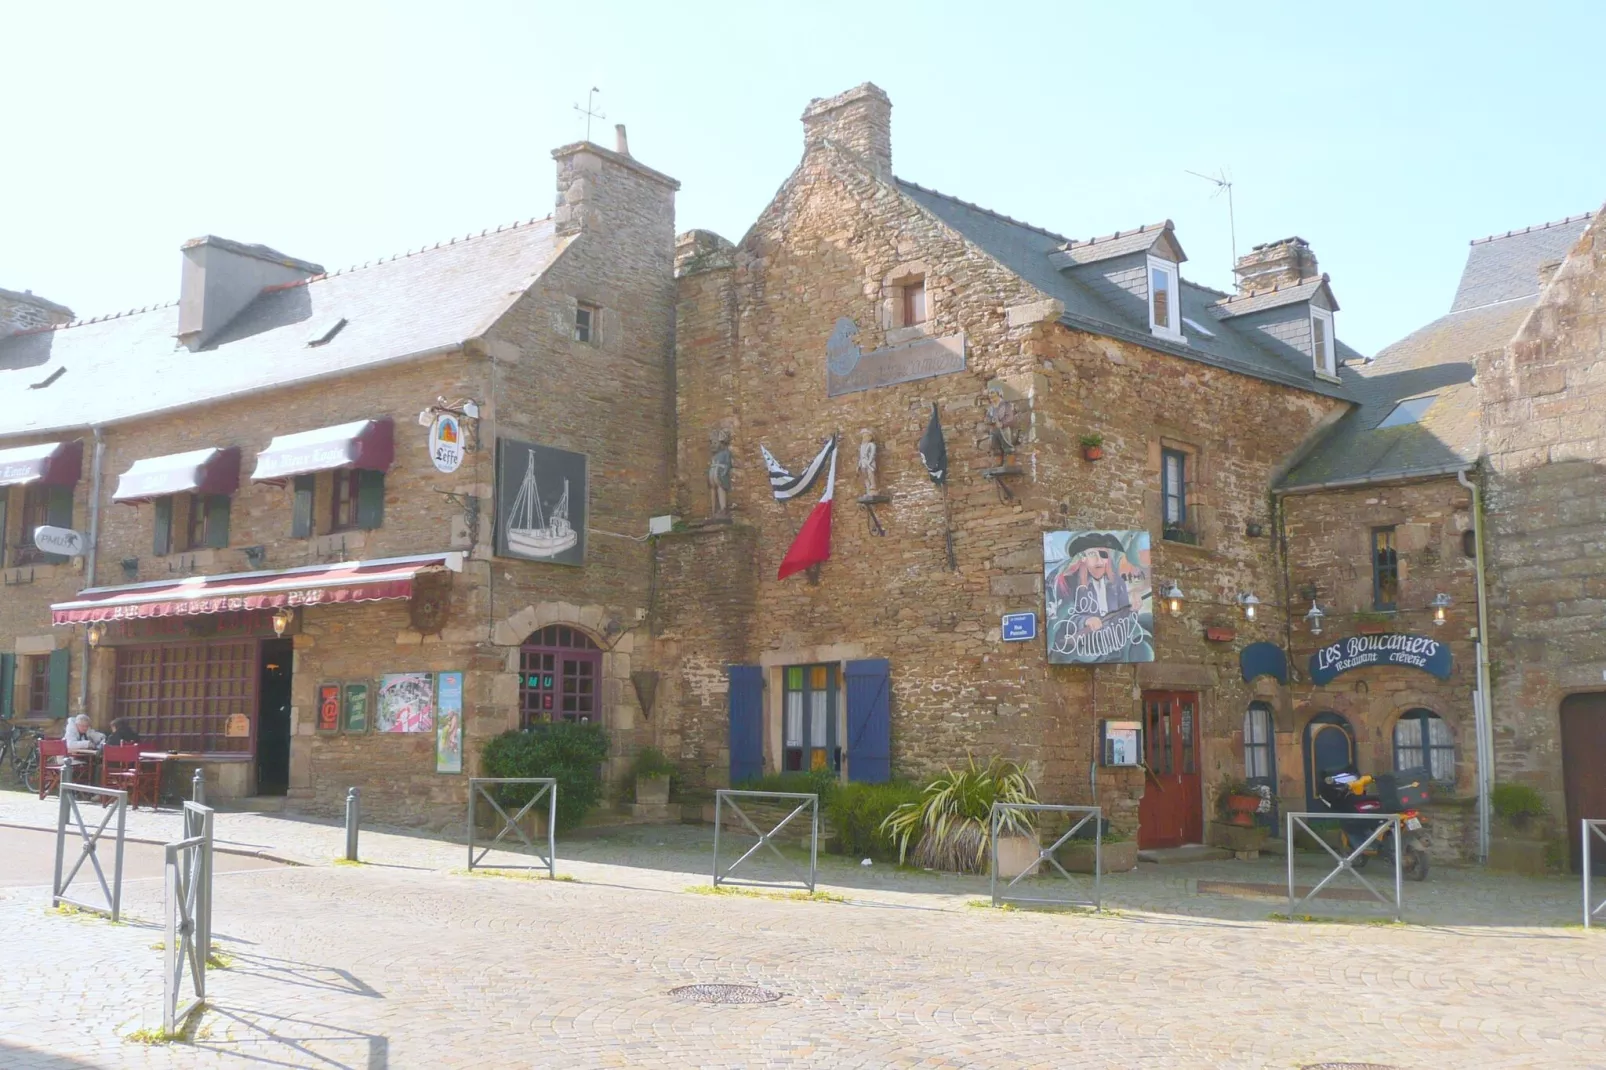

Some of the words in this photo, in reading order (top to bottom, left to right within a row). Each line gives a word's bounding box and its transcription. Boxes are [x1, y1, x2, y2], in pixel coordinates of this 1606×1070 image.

[436, 447, 458, 465] Leffe
[41, 534, 65, 547] PMU
[288, 589, 324, 606] PMU
[1068, 584, 1099, 615] Les
[1319, 643, 1342, 671] Les
[1346, 634, 1440, 658] Boucaniers
[1335, 652, 1379, 672] restaurant
[1389, 650, 1427, 668] crêperie
